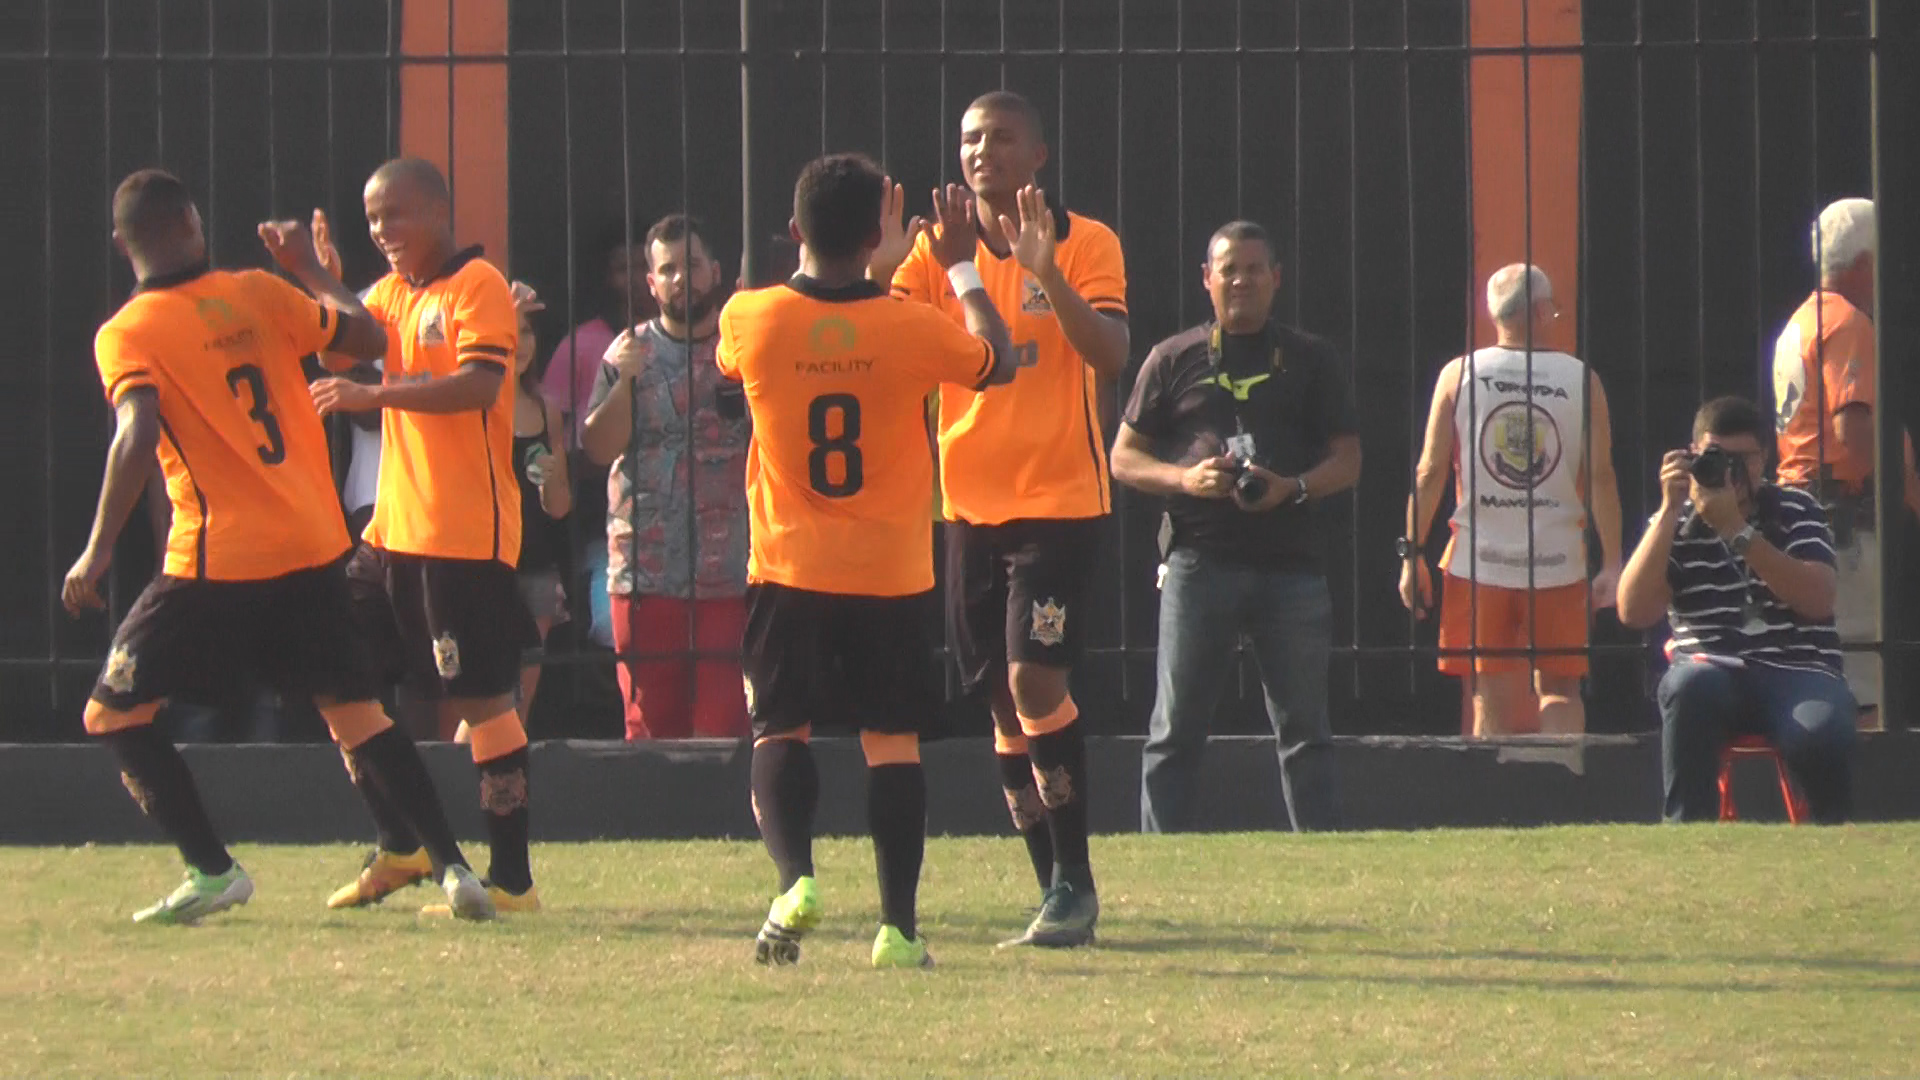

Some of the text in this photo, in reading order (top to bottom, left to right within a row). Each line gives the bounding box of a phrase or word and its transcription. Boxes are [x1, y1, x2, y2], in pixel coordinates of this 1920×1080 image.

[225, 363, 286, 465] 3
[795, 359, 874, 375] FACILITY
[808, 392, 863, 498] 8
